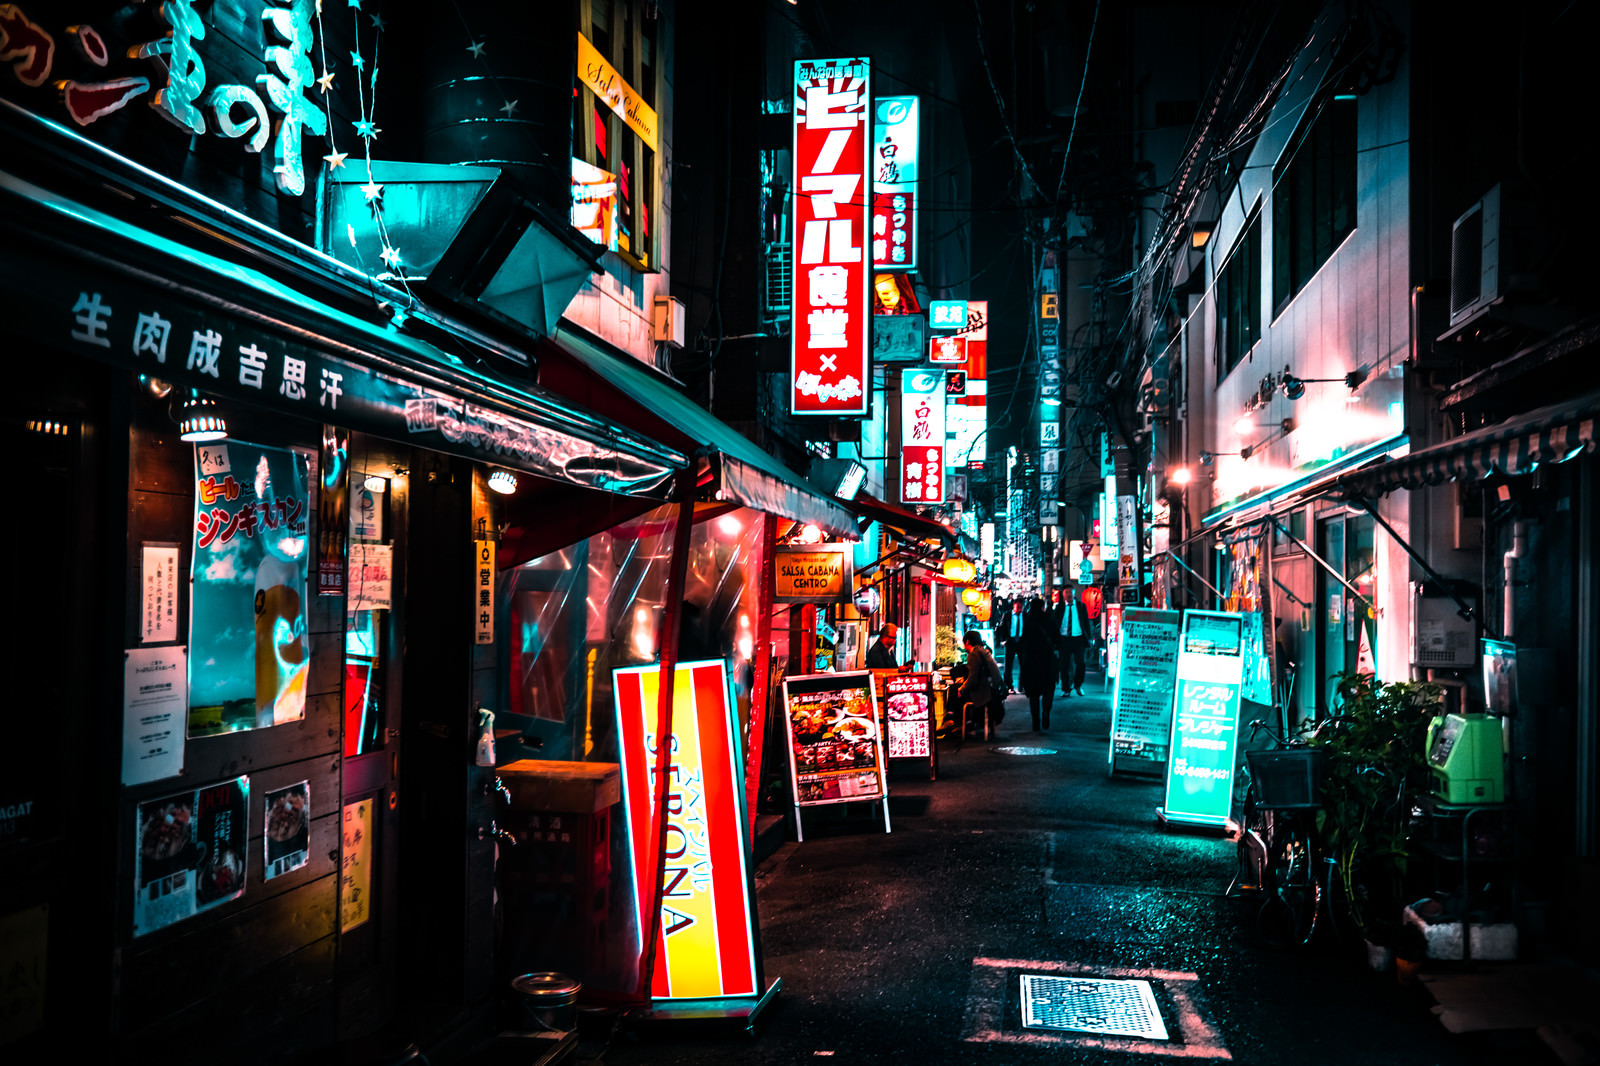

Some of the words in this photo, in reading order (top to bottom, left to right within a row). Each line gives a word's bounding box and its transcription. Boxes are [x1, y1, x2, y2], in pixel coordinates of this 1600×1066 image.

[587, 62, 621, 104] Salsa
[622, 93, 651, 135] Cabana
[71, 291, 344, 411] 生肉成吉思汗
[197, 496, 302, 548] ジンギスカン
[781, 565, 804, 577] SALSA
[808, 565, 840, 576] CABANA
[793, 578, 828, 589] CENTRO
[480, 568, 491, 629] 営業中
[1189, 698, 1226, 715] ルーム
